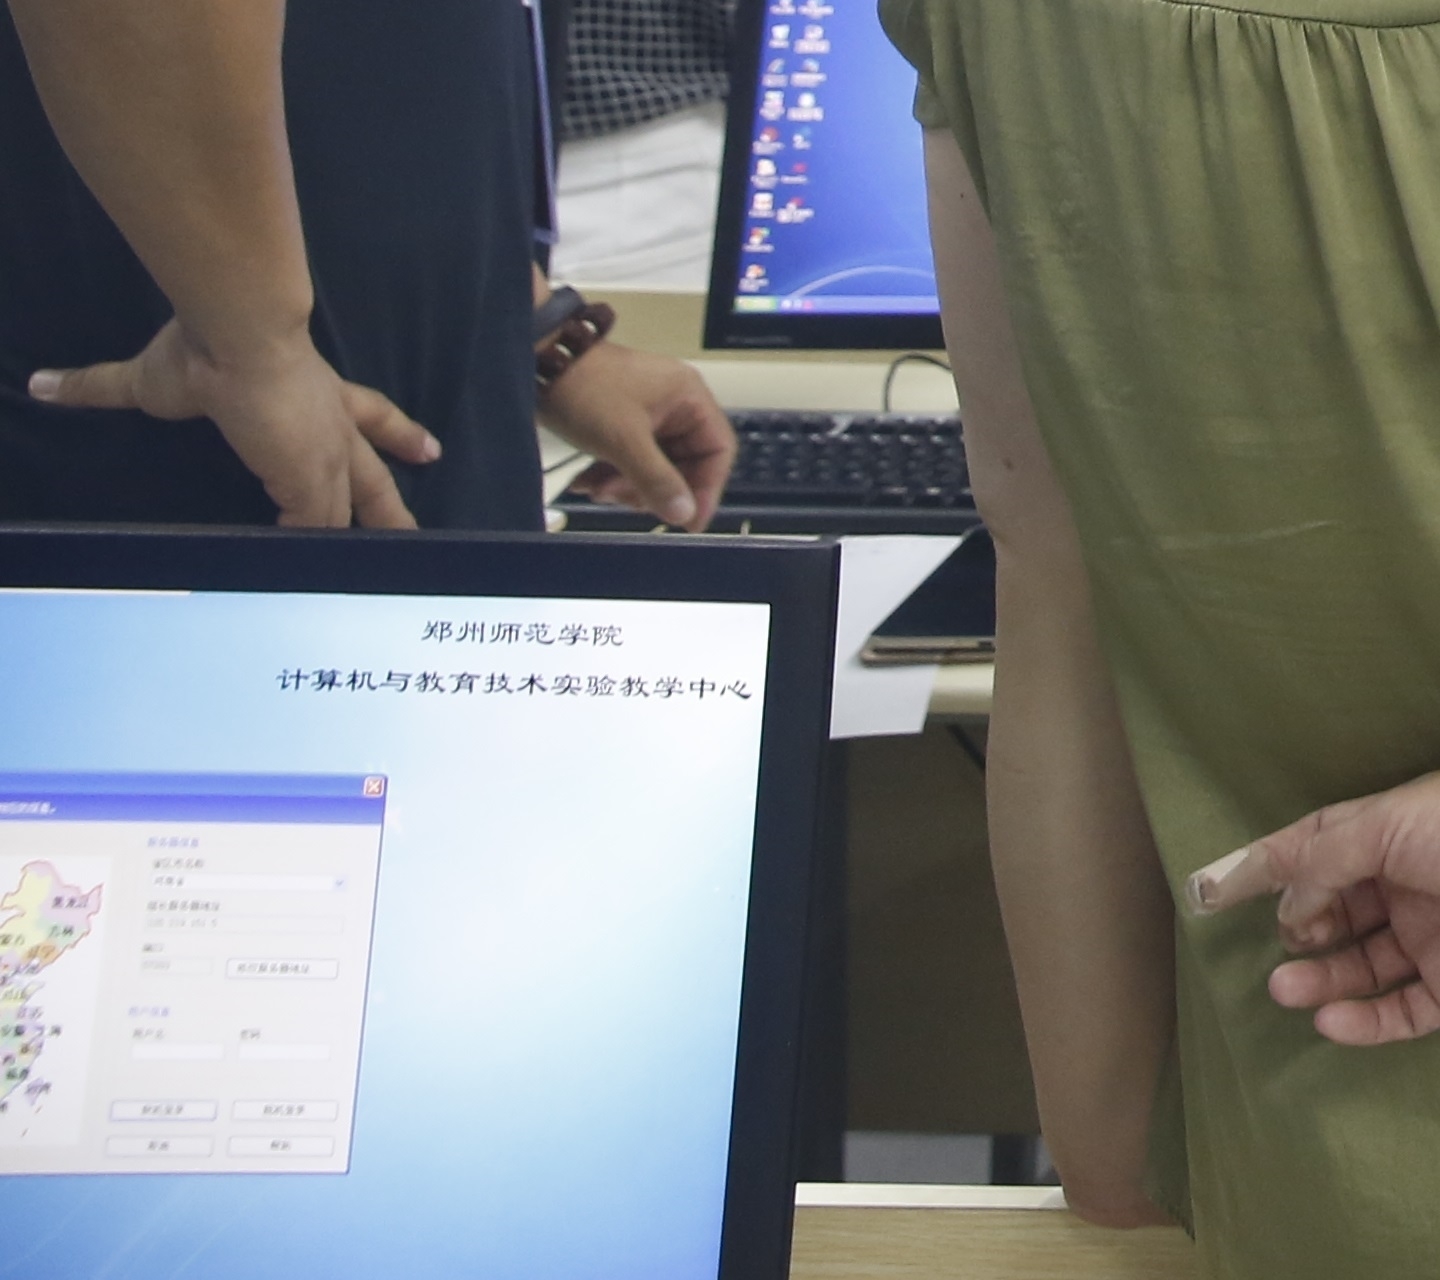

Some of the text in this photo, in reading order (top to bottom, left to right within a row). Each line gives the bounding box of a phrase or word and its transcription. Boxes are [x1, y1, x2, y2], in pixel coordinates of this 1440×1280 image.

[421, 619, 624, 647] 郑州师范学院
[275, 668, 753, 700] 计算机与教育技术实验教学中心
